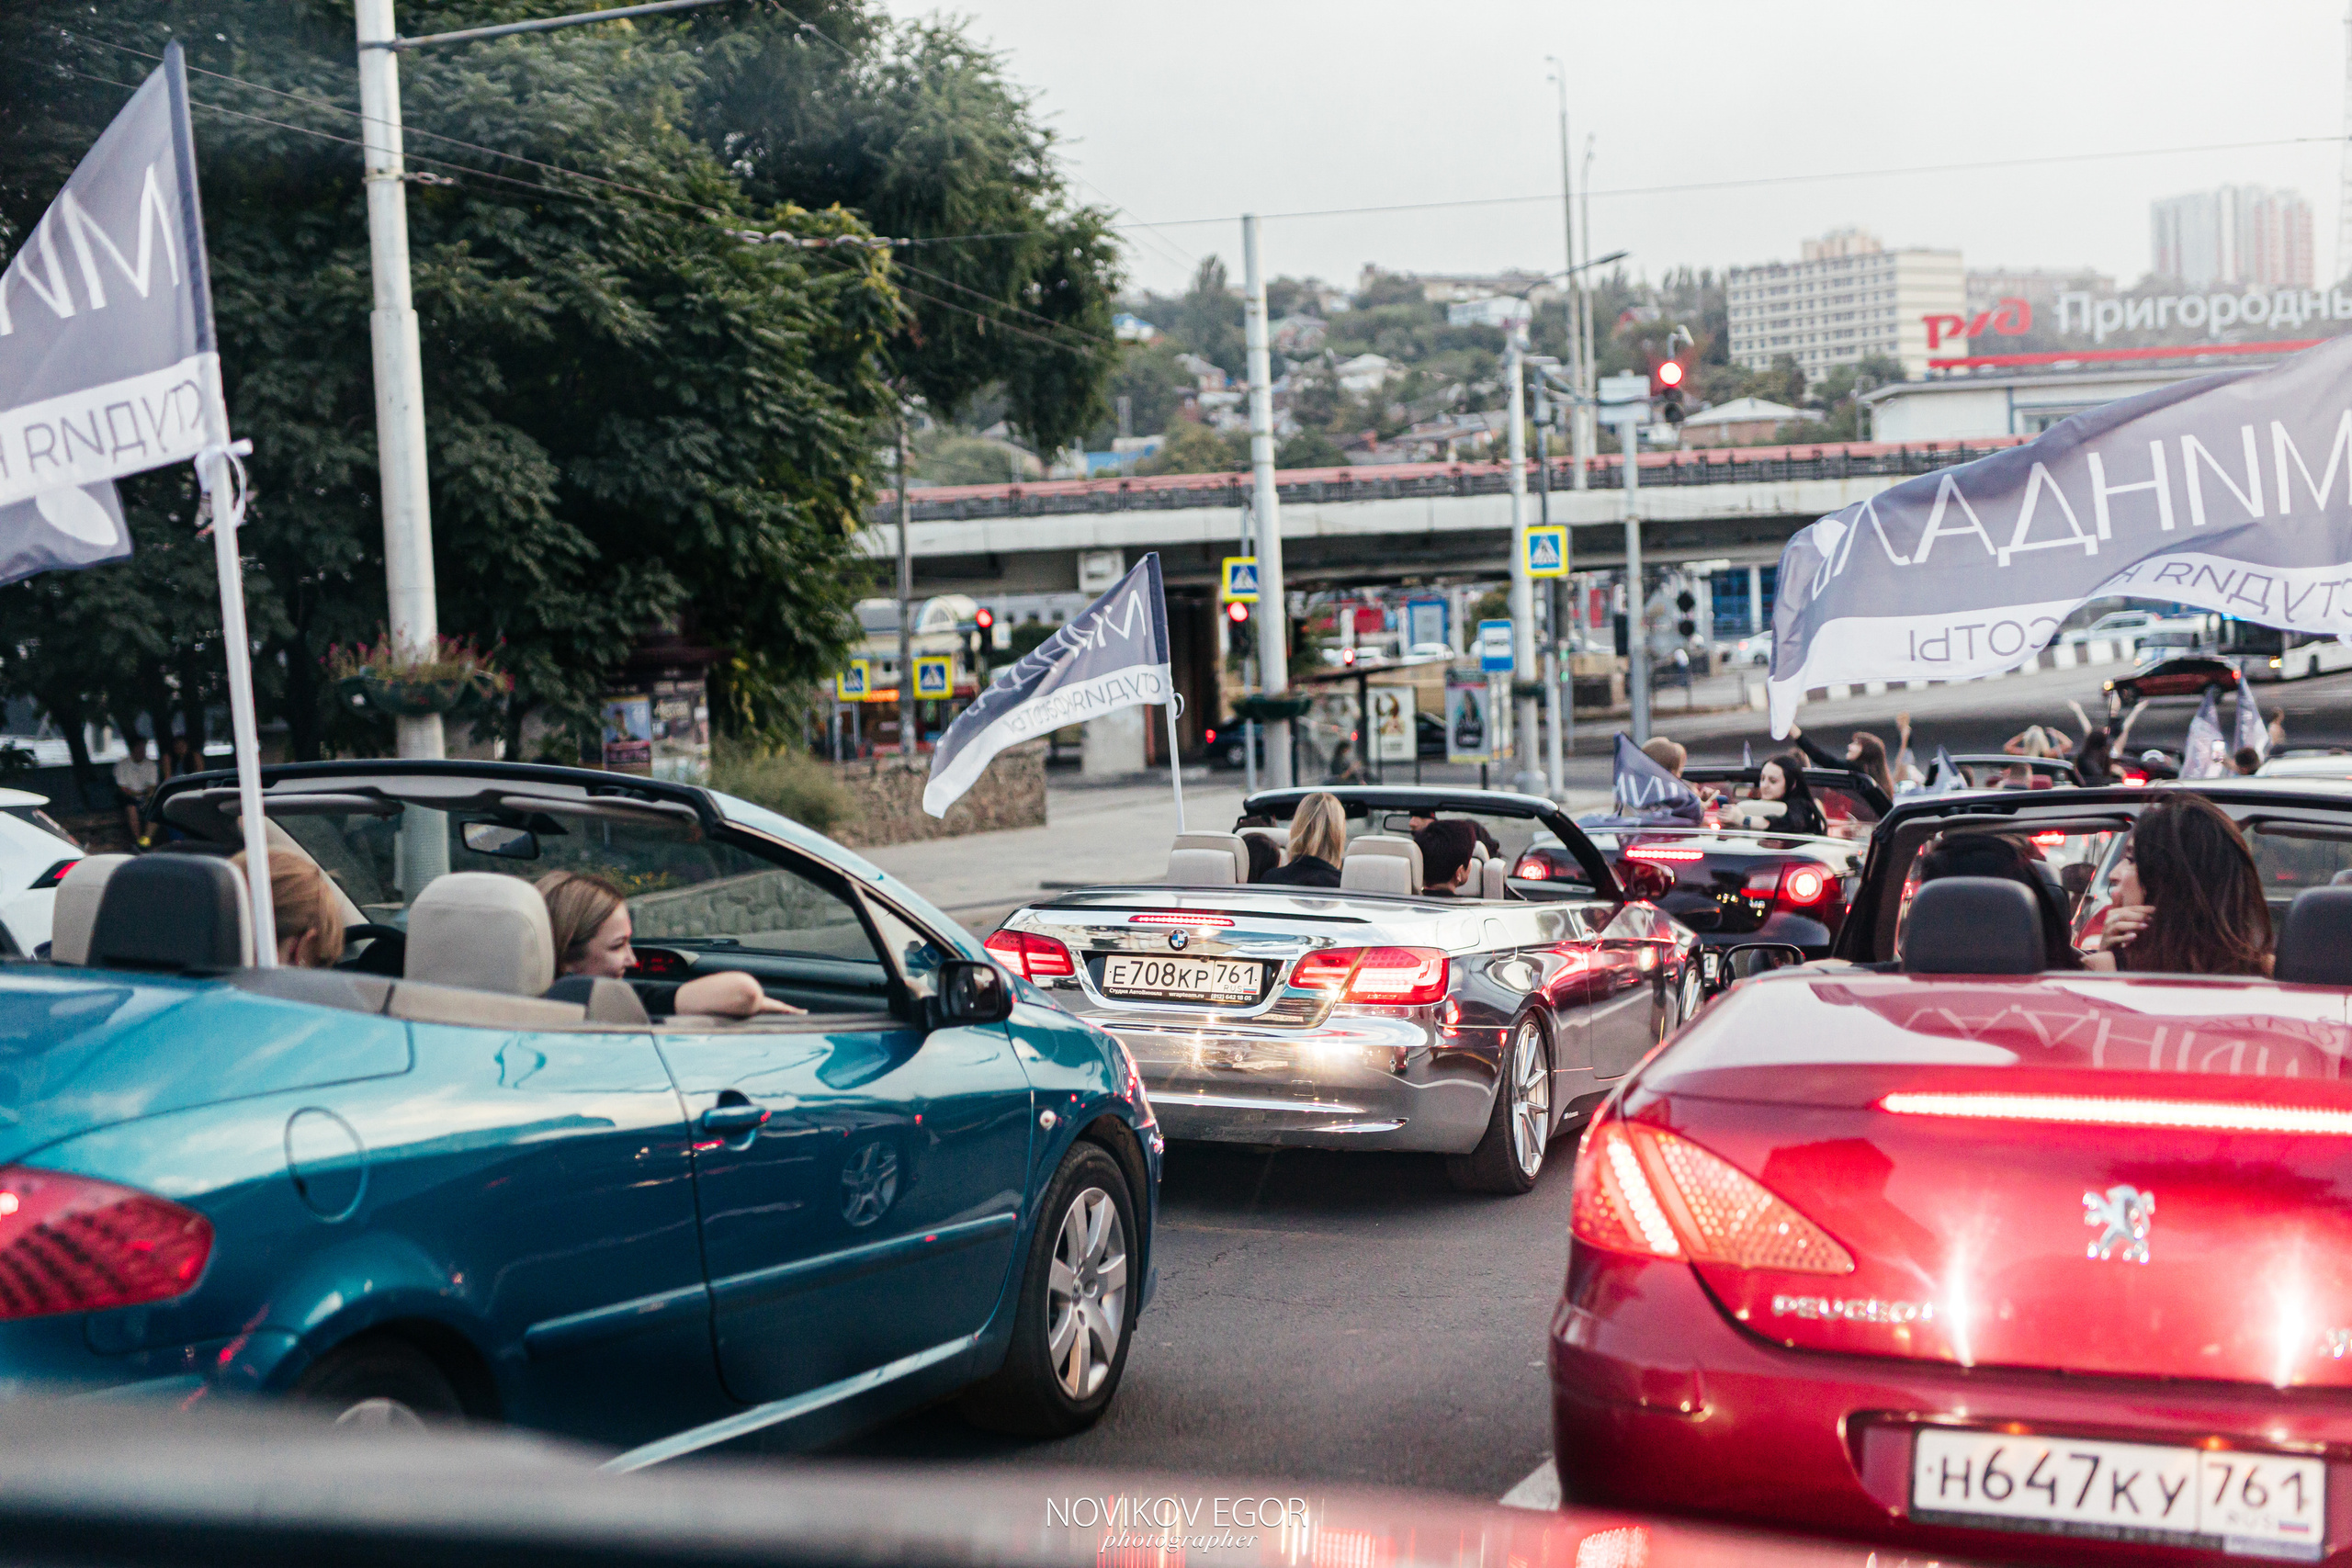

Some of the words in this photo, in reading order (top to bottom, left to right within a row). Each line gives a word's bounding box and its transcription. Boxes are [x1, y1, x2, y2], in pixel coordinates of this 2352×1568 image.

[1112, 960, 1209, 989] Е708КР
[1216, 964, 1255, 986] 761
[1224, 984, 1243, 993] RUS
[2208, 1461, 2308, 1516] 761
